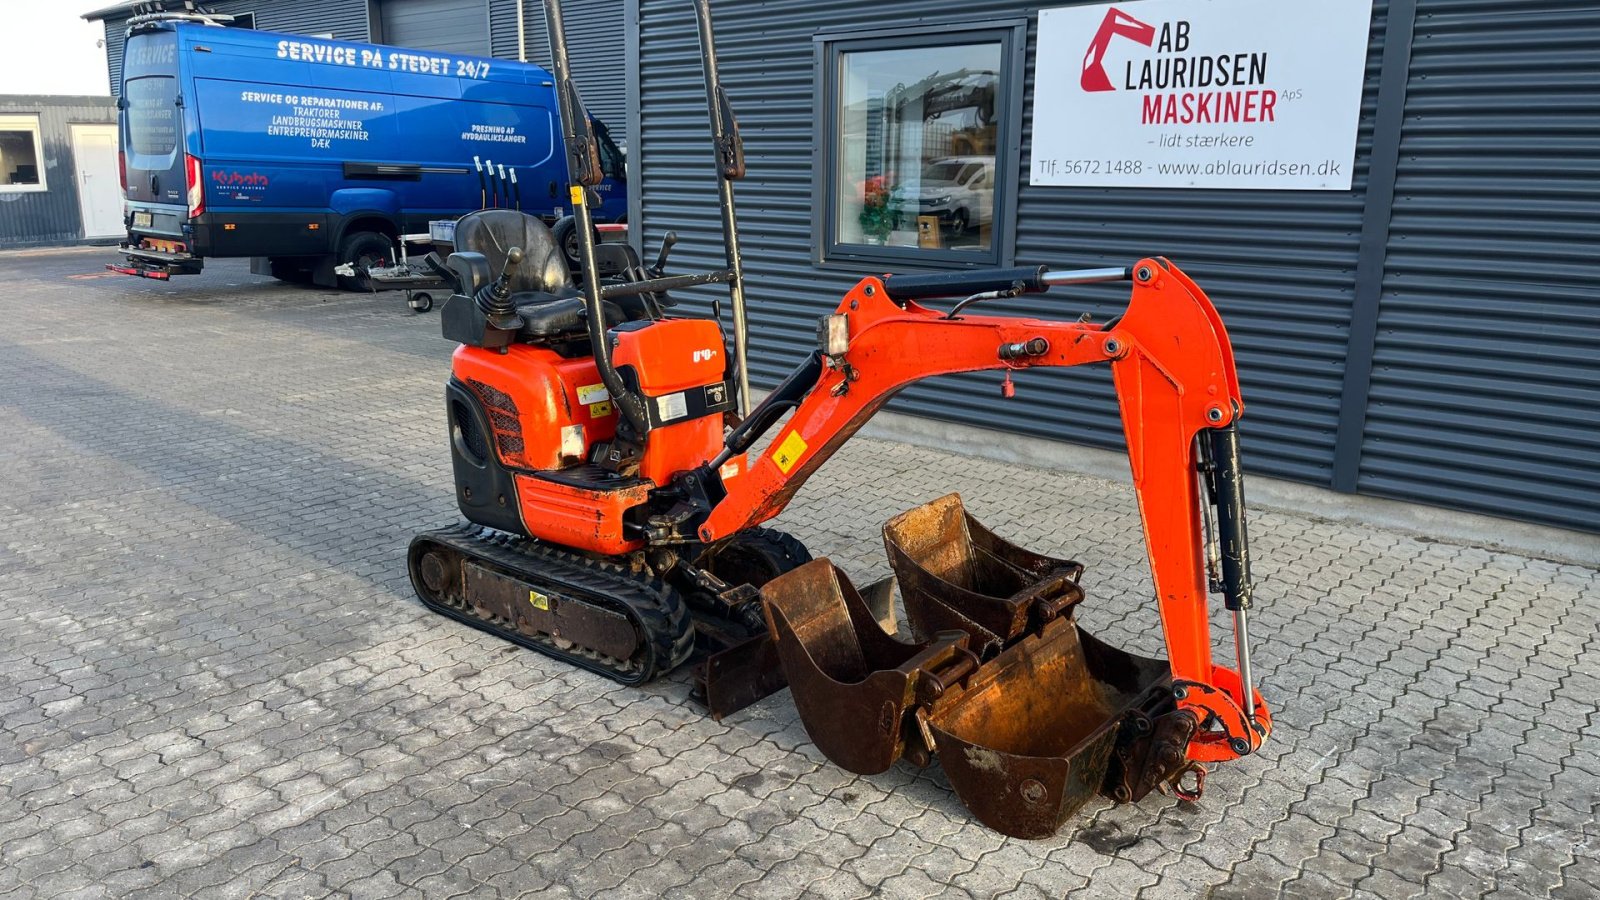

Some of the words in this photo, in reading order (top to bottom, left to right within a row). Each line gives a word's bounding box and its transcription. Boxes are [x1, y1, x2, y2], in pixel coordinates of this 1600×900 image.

[1157, 21, 1191, 53] AB
[277, 40, 356, 66] SERVICE
[361, 48, 383, 68] PÅ
[389, 53, 450, 75] STEDET
[456, 60, 490, 79] 24/7
[1125, 52, 1267, 90] LAURIDSEN
[241, 91, 282, 104] SERVICE
[285, 95, 298, 105] OG
[300, 96, 369, 110] REPARATIONER
[370, 102, 384, 111] AF:
[1141, 90, 1277, 125] MASKINER
[1280, 88, 1303, 102] ApS
[293, 106, 340, 119] TRAKTORER
[272, 115, 363, 130] LANDBRUGSMASKINER
[471, 124, 505, 134] PRESNING
[506, 126, 515, 135] AF
[268, 125, 369, 141] ENTREPRENØRMASKINER
[461, 131, 526, 144] HYDRAULIKSLANGER
[1159, 133, 1182, 148] lidt
[1185, 132, 1254, 148] stærkere
[311, 138, 330, 149] DÆK
[1038, 159, 1060, 177] Tlf.
[1065, 160, 1100, 174] 5672
[1104, 160, 1142, 174] 1488
[1157, 159, 1341, 176] www.ablauridsen.dk
[212, 170, 269, 185] Kubota
